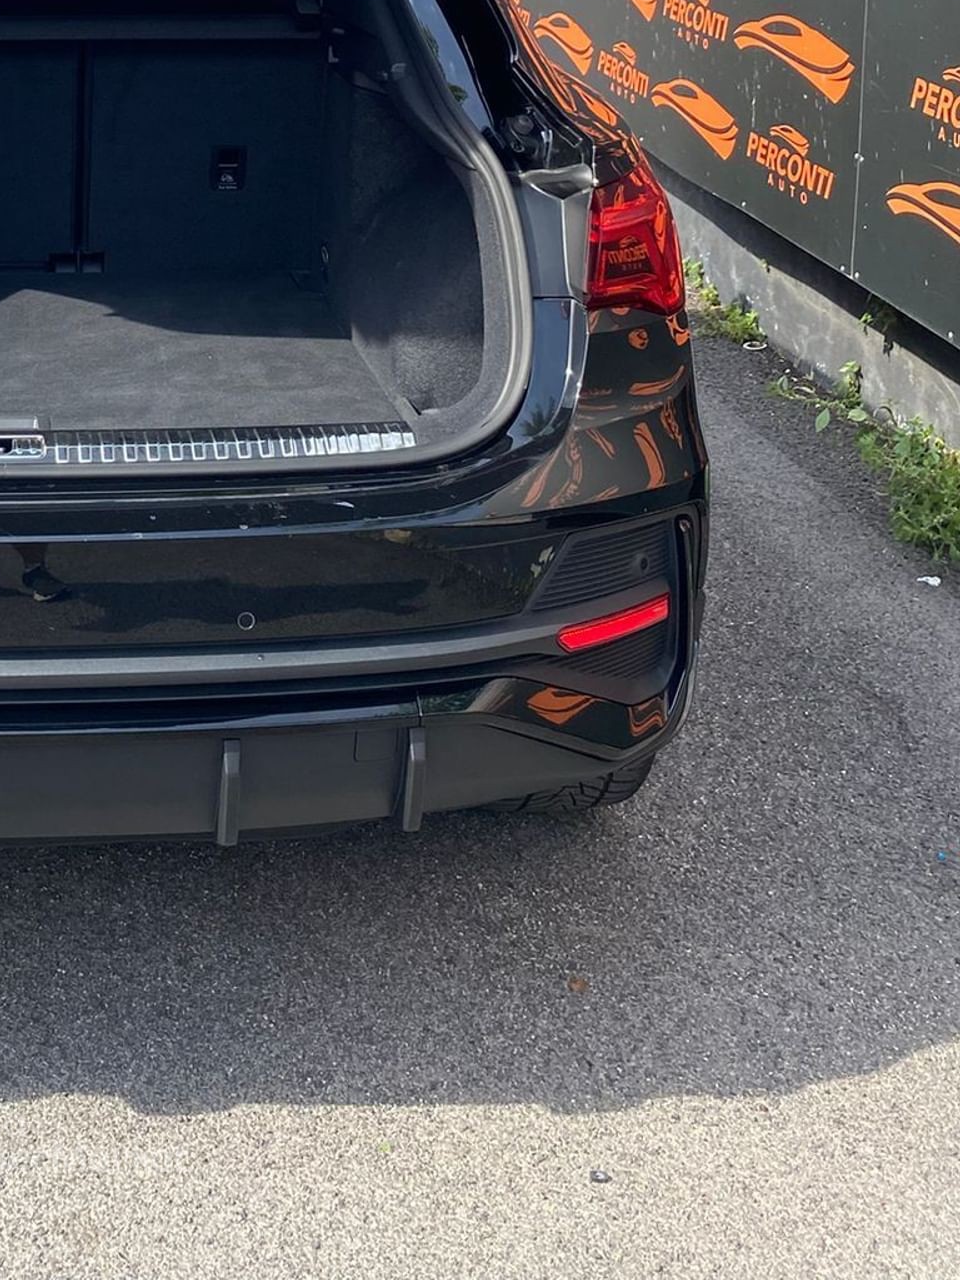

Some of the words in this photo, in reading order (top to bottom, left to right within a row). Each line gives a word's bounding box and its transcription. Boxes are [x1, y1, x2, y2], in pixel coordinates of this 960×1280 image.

[677, 26, 710, 50] AUTO
[597, 50, 649, 99] PERCONTI
[610, 81, 636, 104] AUTO
[746, 131, 835, 200] PERCONTI
[767, 172, 809, 205] AUTO
